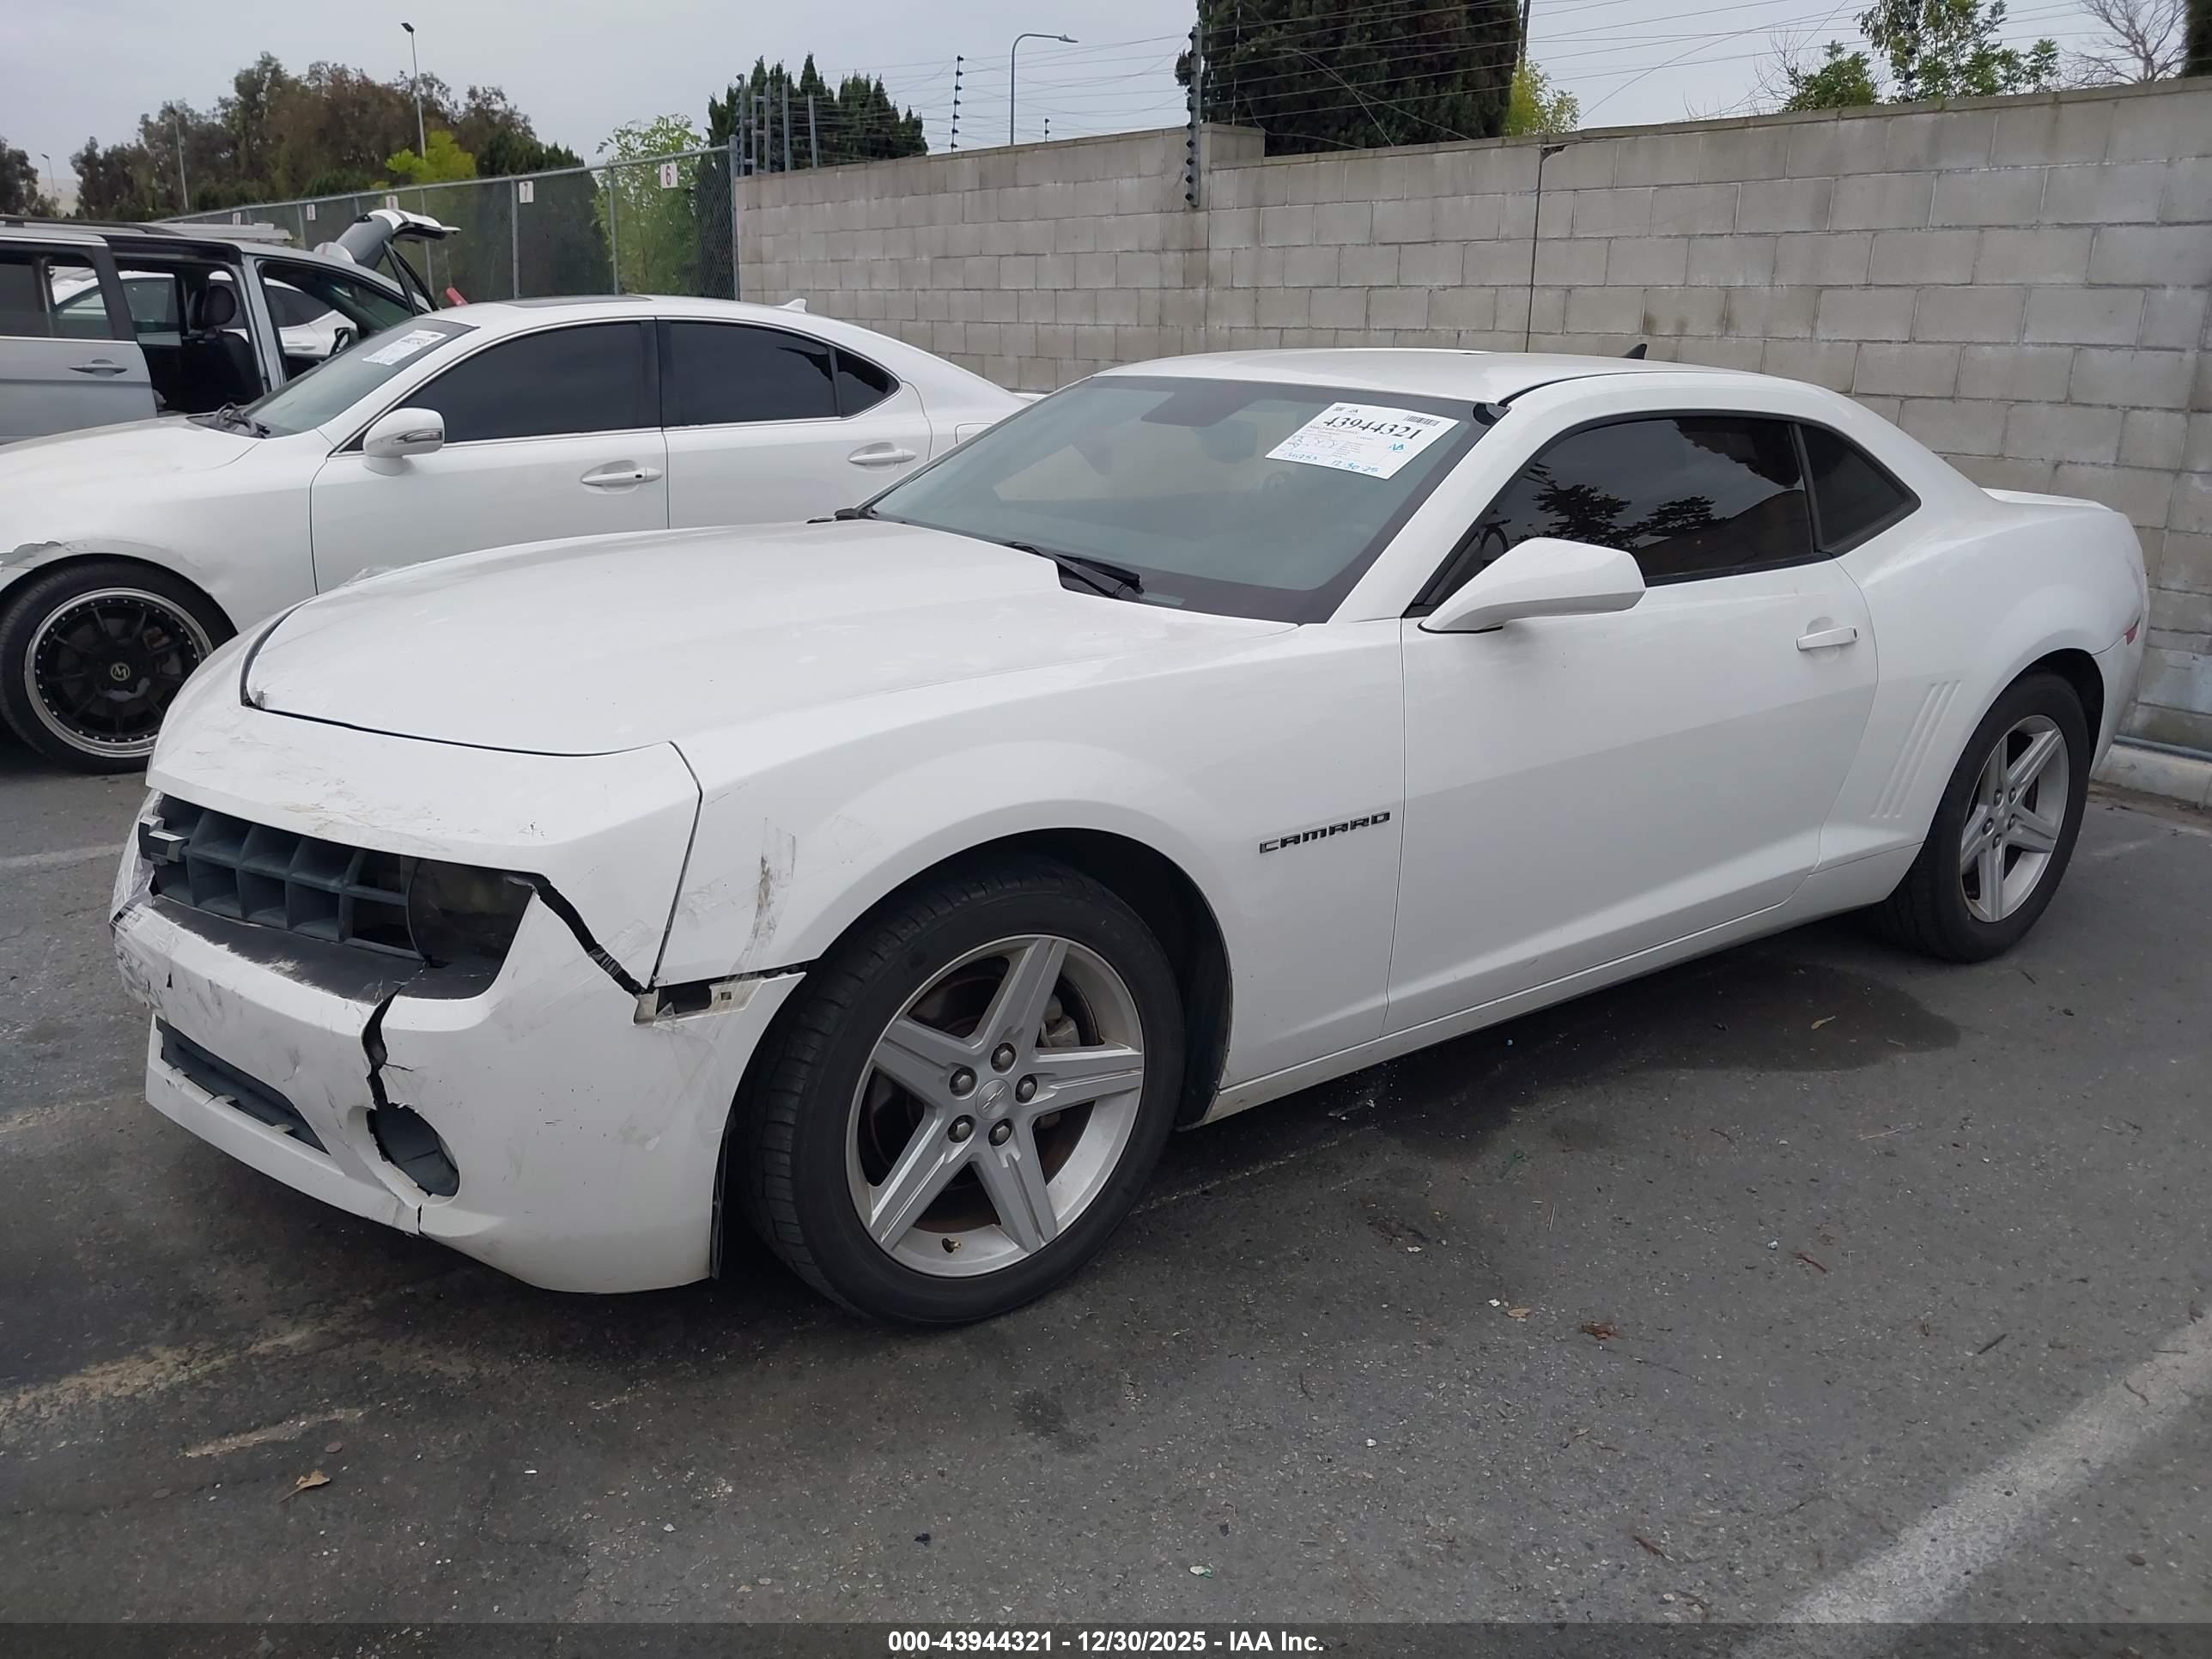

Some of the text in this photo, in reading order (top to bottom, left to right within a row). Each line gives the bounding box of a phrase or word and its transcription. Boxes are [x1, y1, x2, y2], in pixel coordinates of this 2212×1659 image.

[665, 165, 672, 186] 6
[524, 182, 529, 202] 7
[1323, 416, 1423, 440] 43944321
[1260, 811, 1390, 854] CAMARO
